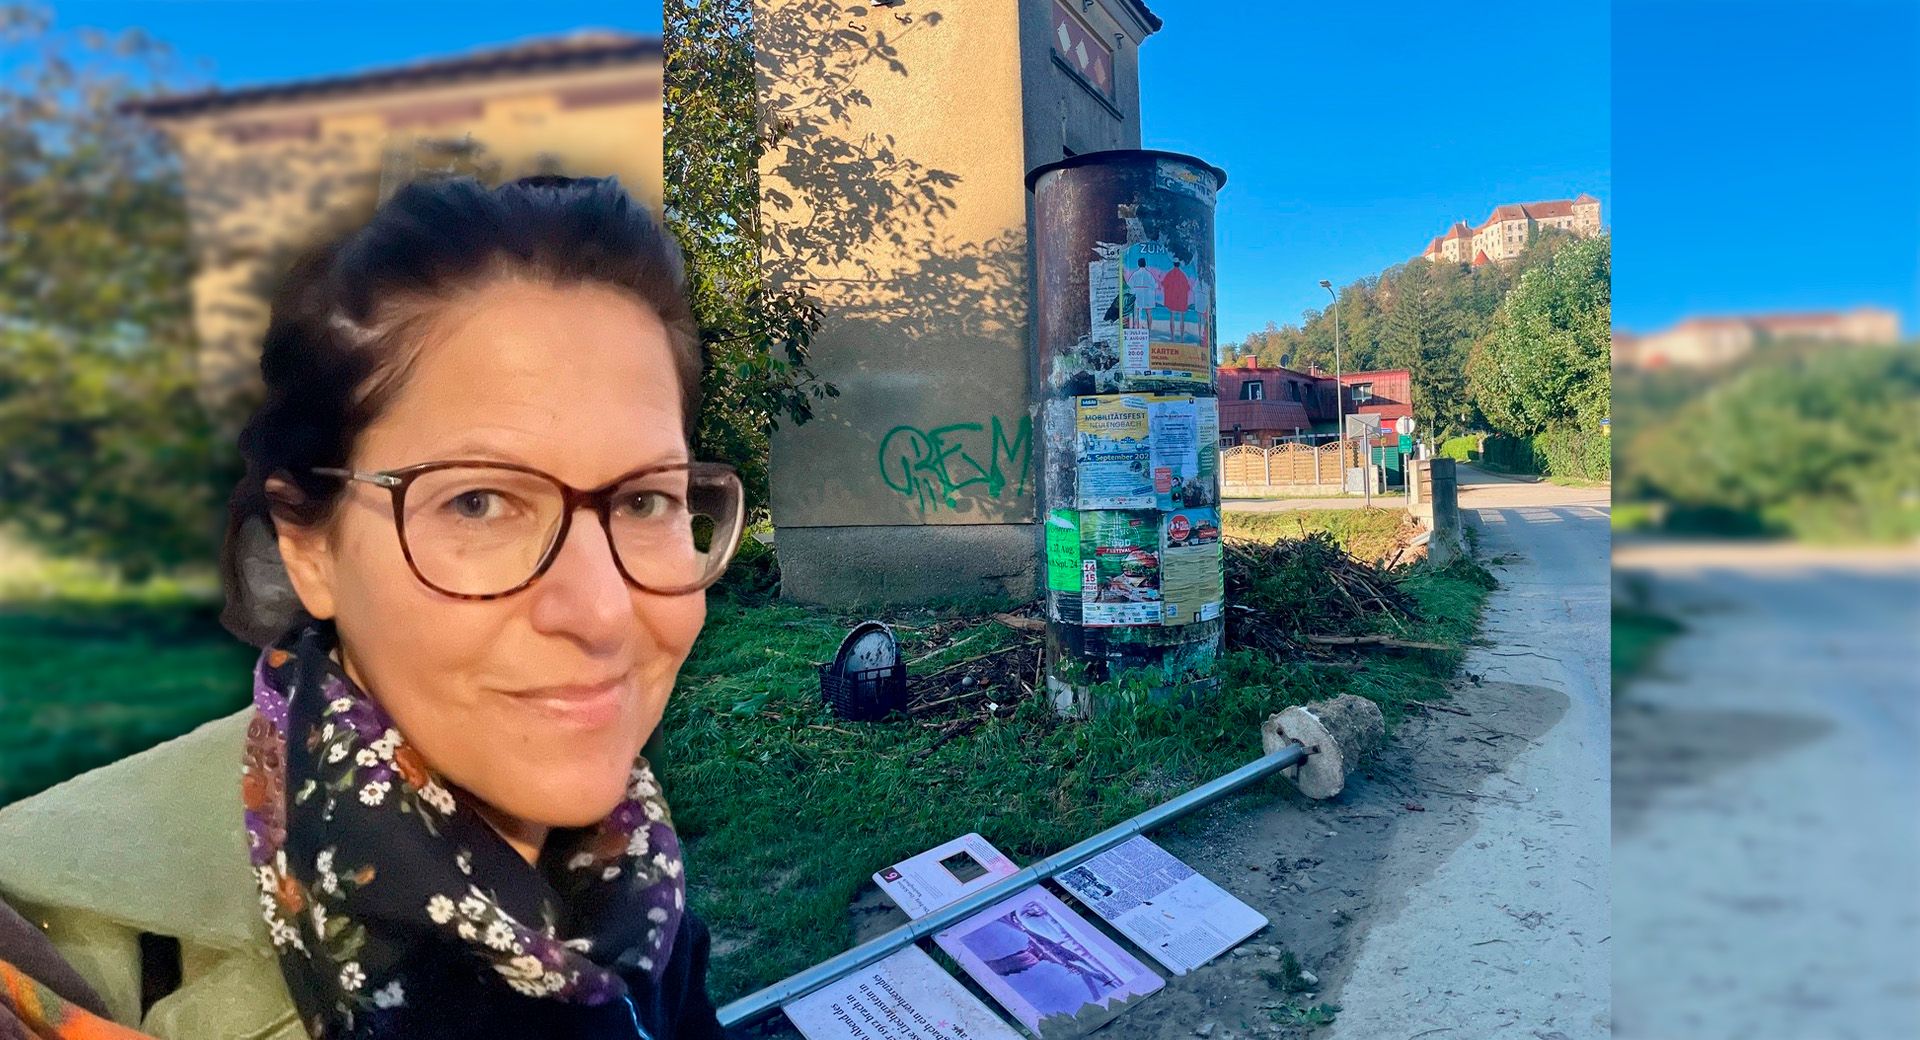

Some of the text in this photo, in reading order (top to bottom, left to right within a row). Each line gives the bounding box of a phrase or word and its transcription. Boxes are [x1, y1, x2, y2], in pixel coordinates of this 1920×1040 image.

[1151, 348, 1180, 356] KARTEN
[1085, 412, 1145, 422] MOBILITÄTSFEST
[1090, 420, 1142, 429] NEULENGBACH
[1096, 454, 1134, 462] September
[1086, 574, 1096, 582] 15
[885, 872, 898, 880] 6
[859, 983, 870, 993] in
[846, 994, 857, 1004] in
[872, 974, 919, 1016] verheerendes
[854, 1002, 876, 1024] brach
[866, 990, 911, 1035] Liechtenstein
[913, 1008, 932, 1027] ein
[830, 1003, 863, 1036] Abend des
[872, 1018, 889, 1037] 1912
